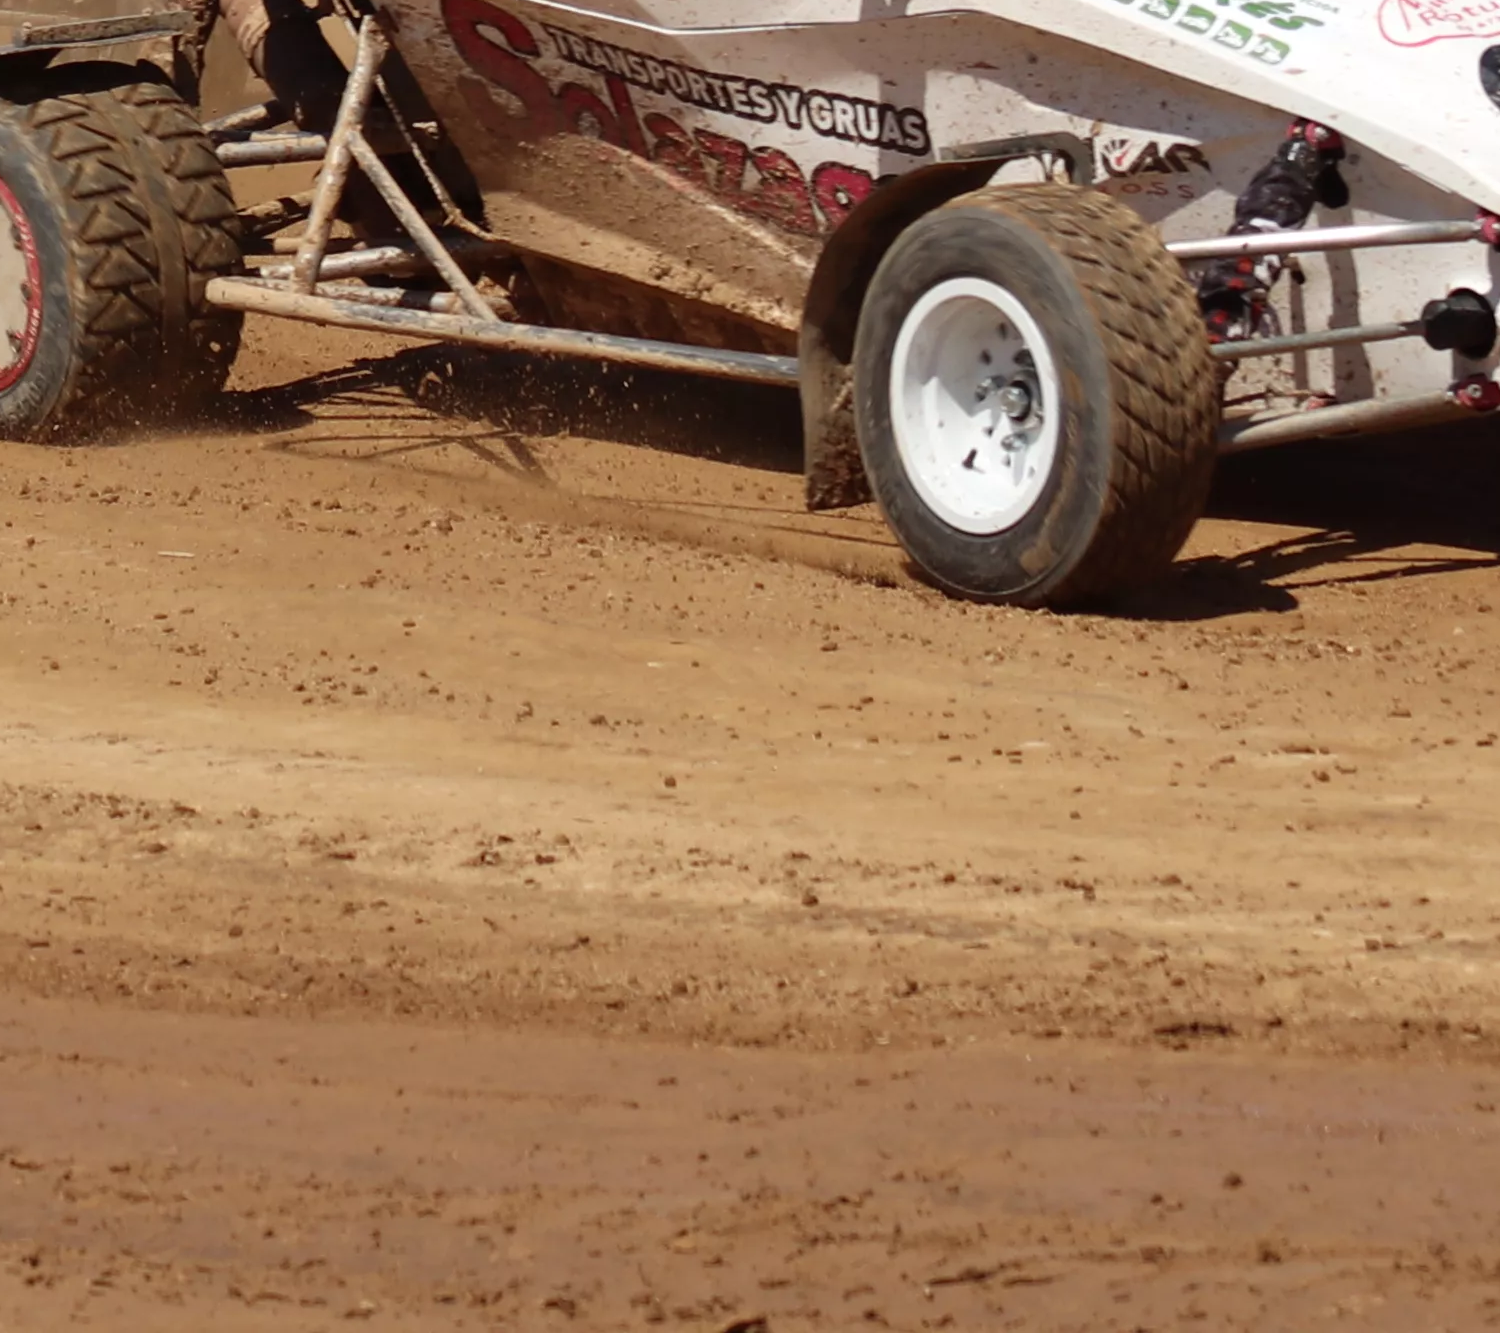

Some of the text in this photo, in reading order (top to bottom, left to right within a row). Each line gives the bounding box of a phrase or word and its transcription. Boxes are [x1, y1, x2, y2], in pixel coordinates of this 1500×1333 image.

[543, 25, 930, 156] TRANSPORTES Y GRUAS
